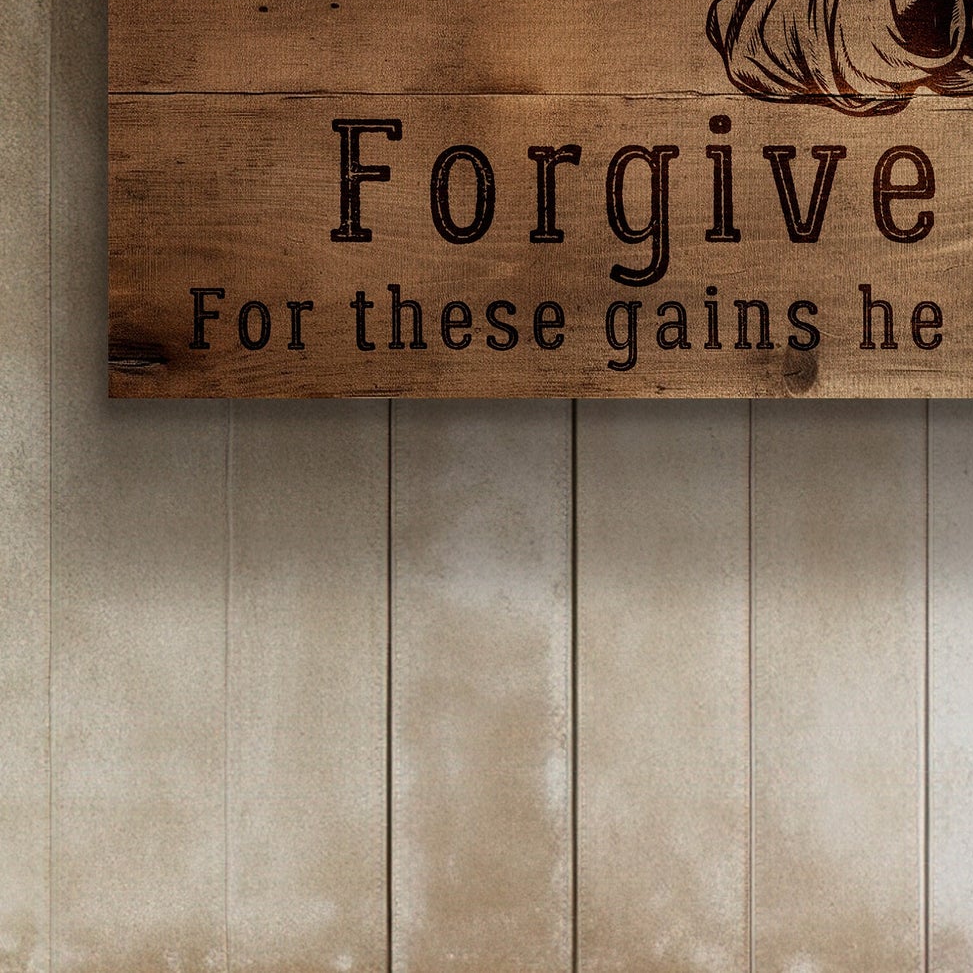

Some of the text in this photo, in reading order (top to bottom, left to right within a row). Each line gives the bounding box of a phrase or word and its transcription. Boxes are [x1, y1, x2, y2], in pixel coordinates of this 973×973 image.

[331, 114, 938, 287] Forgive
[191, 288, 314, 351] For
[351, 284, 566, 351] these
[607, 286, 823, 371] gains
[859, 284, 945, 351] he
